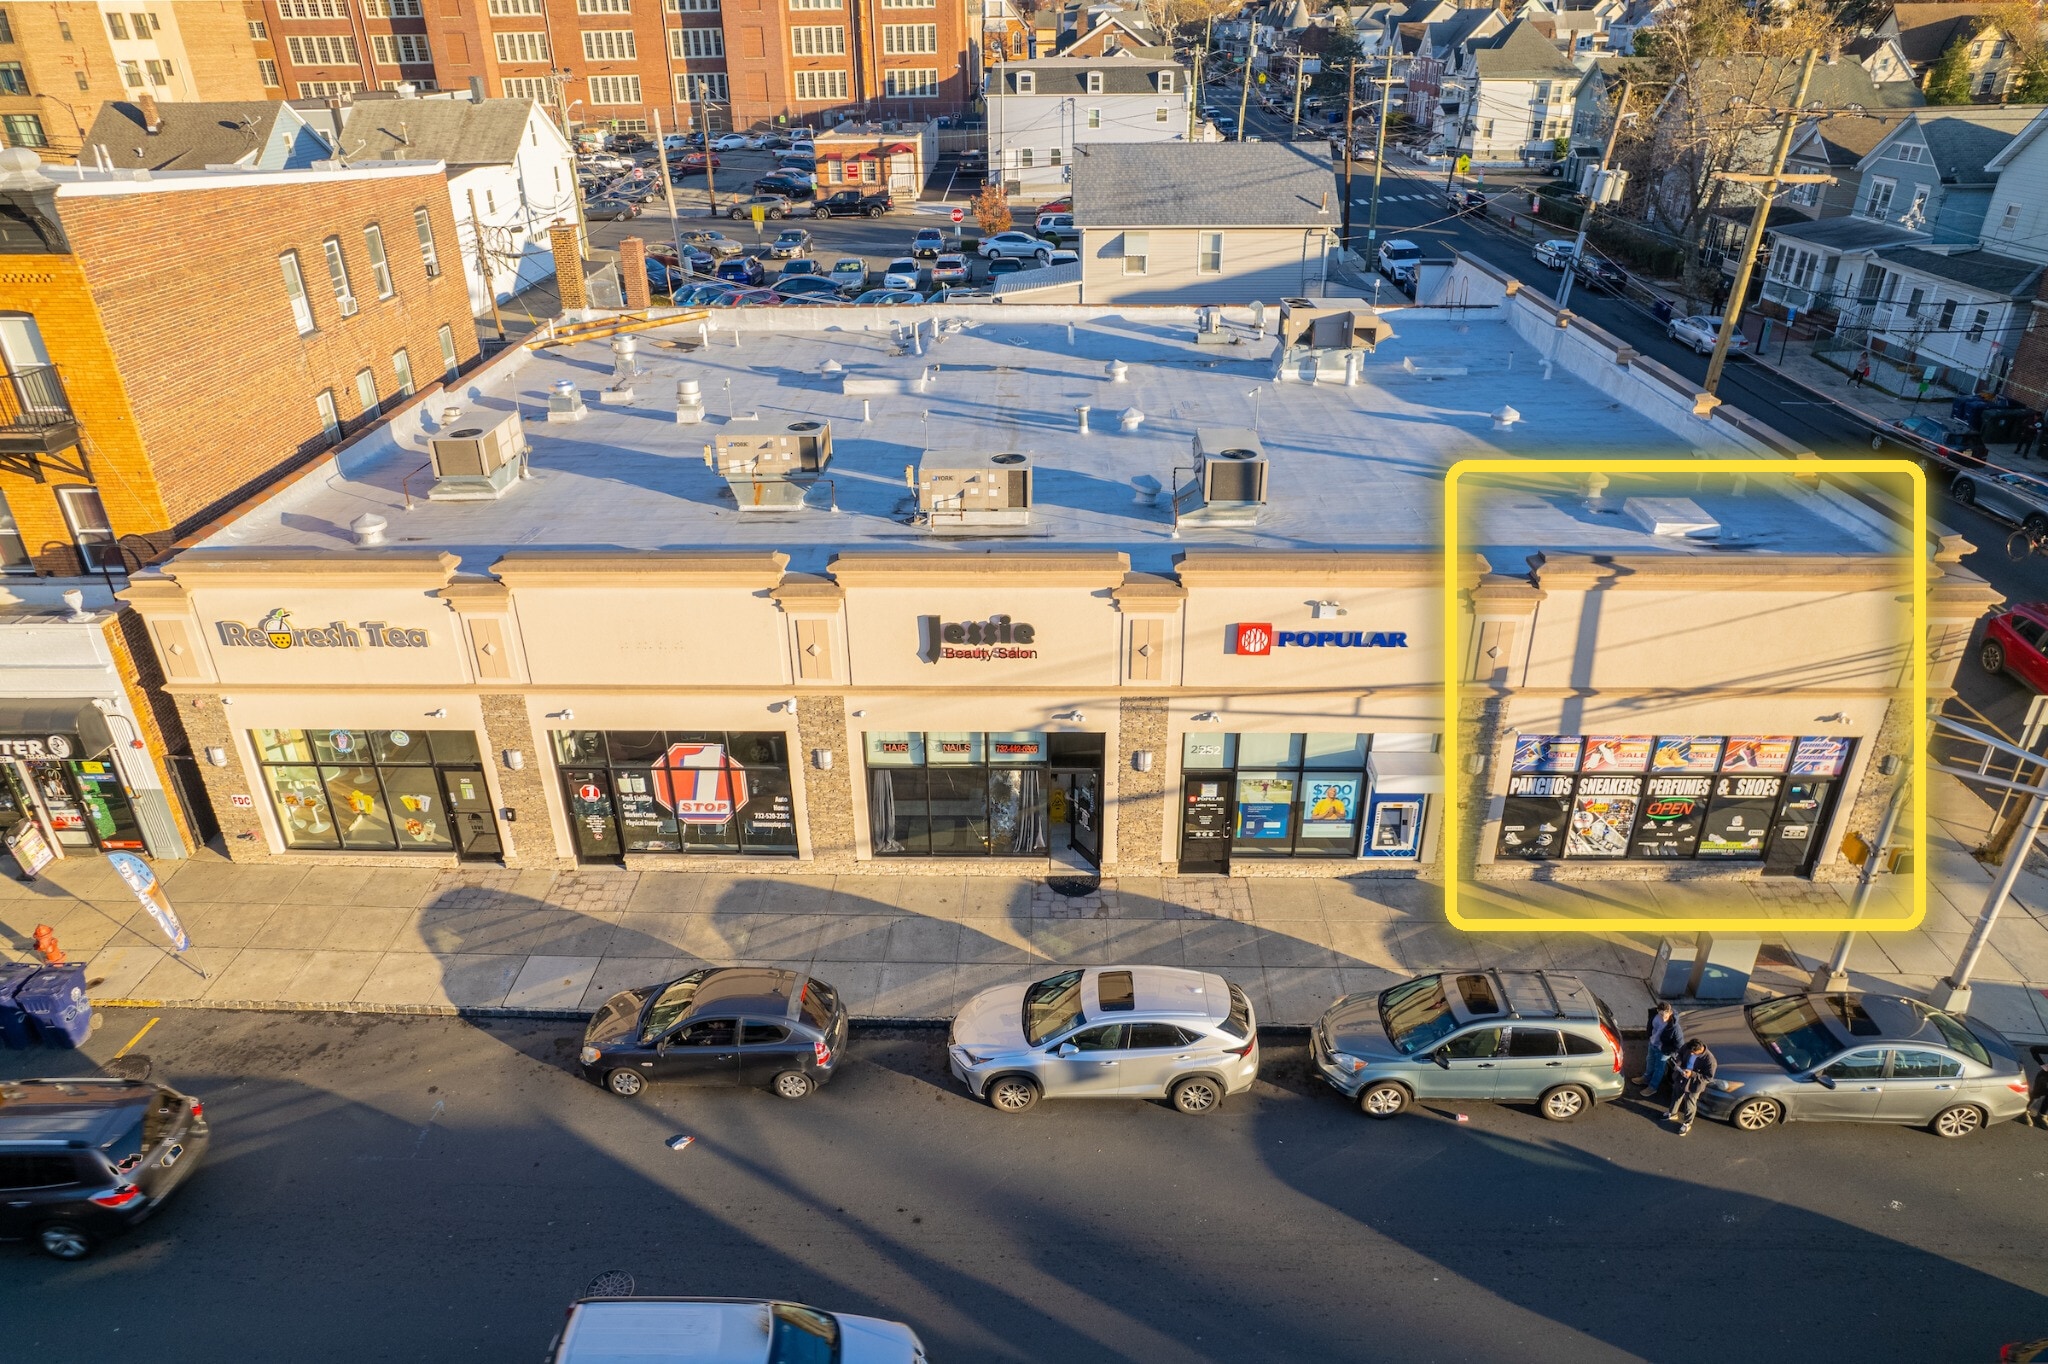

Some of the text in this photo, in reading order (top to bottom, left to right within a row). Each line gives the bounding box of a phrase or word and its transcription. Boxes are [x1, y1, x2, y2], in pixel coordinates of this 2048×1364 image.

[362, 621, 429, 648] Tea
[917, 614, 1036, 665] Jessie
[1277, 631, 1408, 648] POPULAR
[943, 647, 1038, 661] Beauty Salon
[883, 743, 908, 752] HAIR
[942, 743, 971, 752] NAILS
[1199, 745, 1222, 755] 252
[1509, 776, 1780, 796] PANCHO'S SNEAKERS PERFUMES & SHOES
[232, 796, 251, 805] FDC
[681, 802, 728, 812] STOP
[1647, 802, 1695, 815] OPEN
